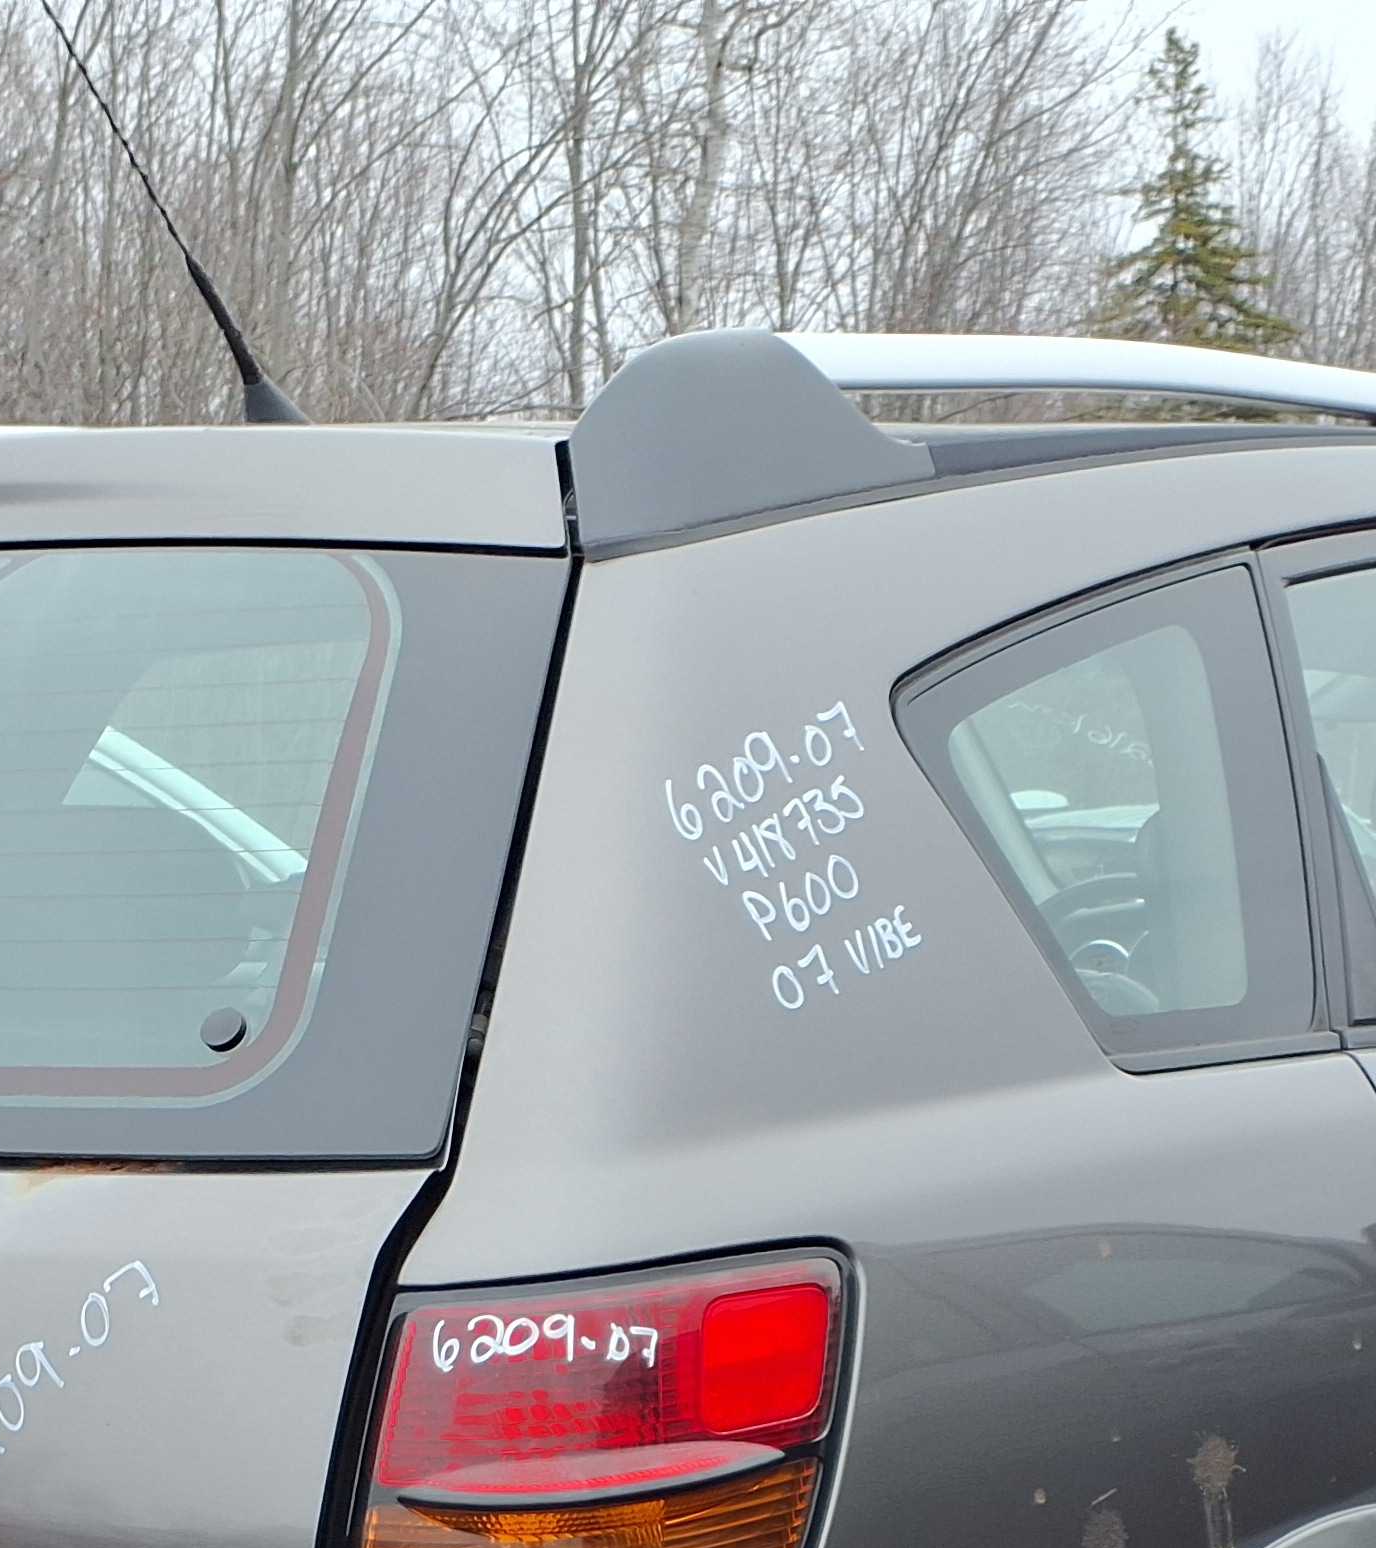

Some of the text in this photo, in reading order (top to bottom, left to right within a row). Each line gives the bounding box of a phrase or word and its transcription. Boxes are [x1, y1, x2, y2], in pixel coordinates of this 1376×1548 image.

[742, 854, 859, 941] P600
[772, 905, 922, 1009] 07 VIBE
